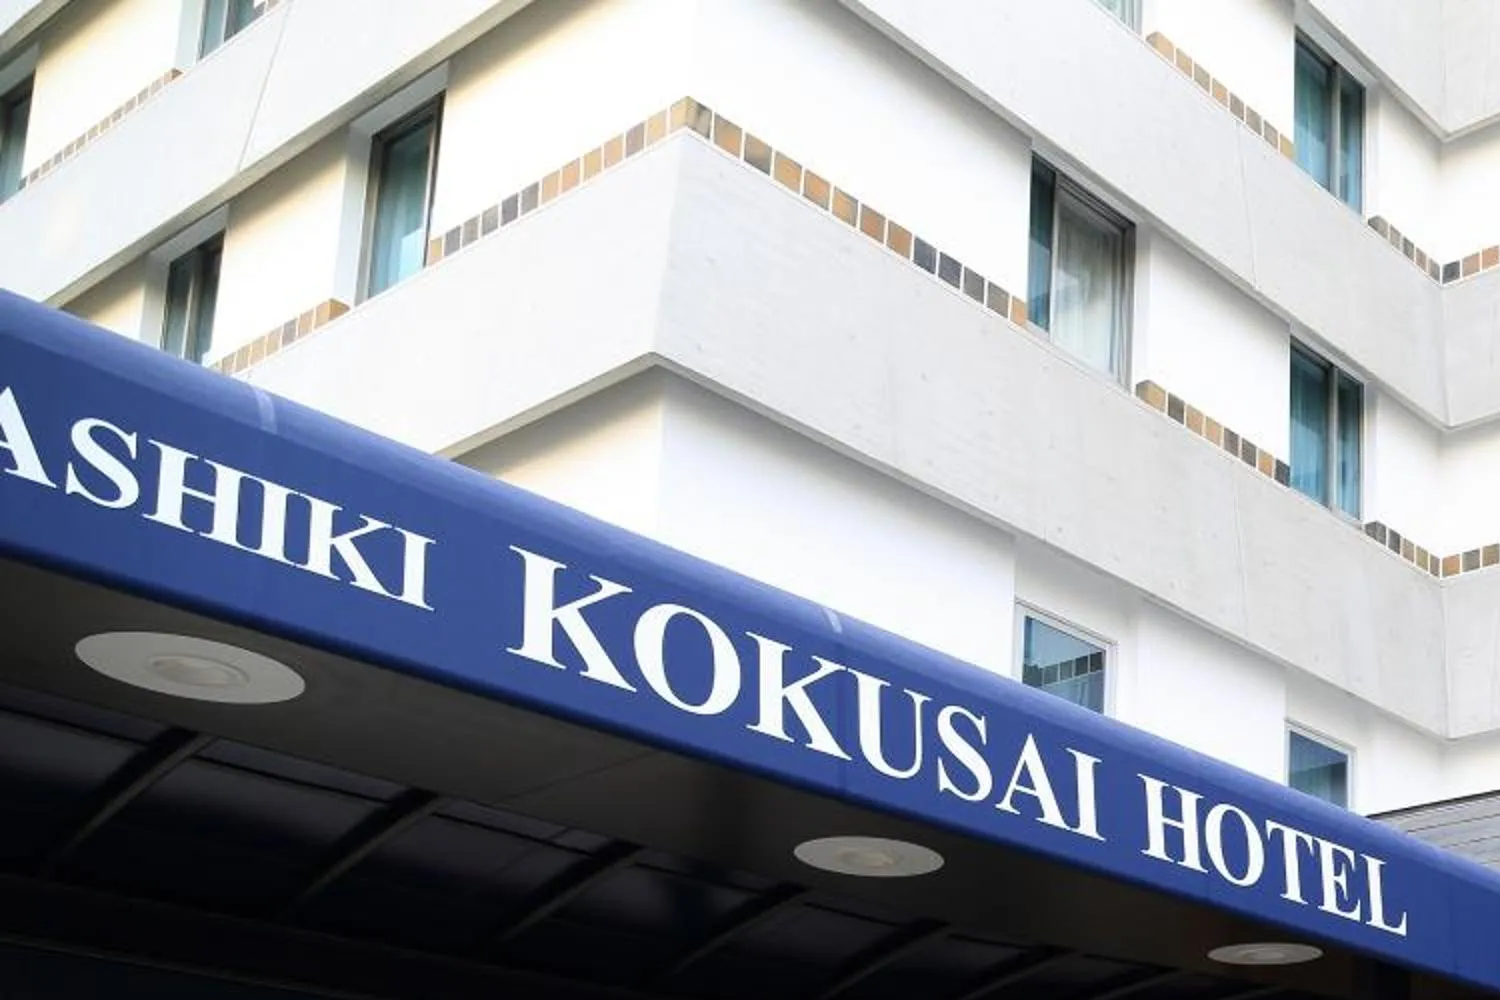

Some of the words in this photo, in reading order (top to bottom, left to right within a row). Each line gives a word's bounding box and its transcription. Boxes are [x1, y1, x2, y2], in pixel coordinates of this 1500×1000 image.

[0, 386, 436, 612] ASHIKI
[505, 545, 1106, 842] KOKUSAI
[1137, 773, 1408, 937] HOTEL
